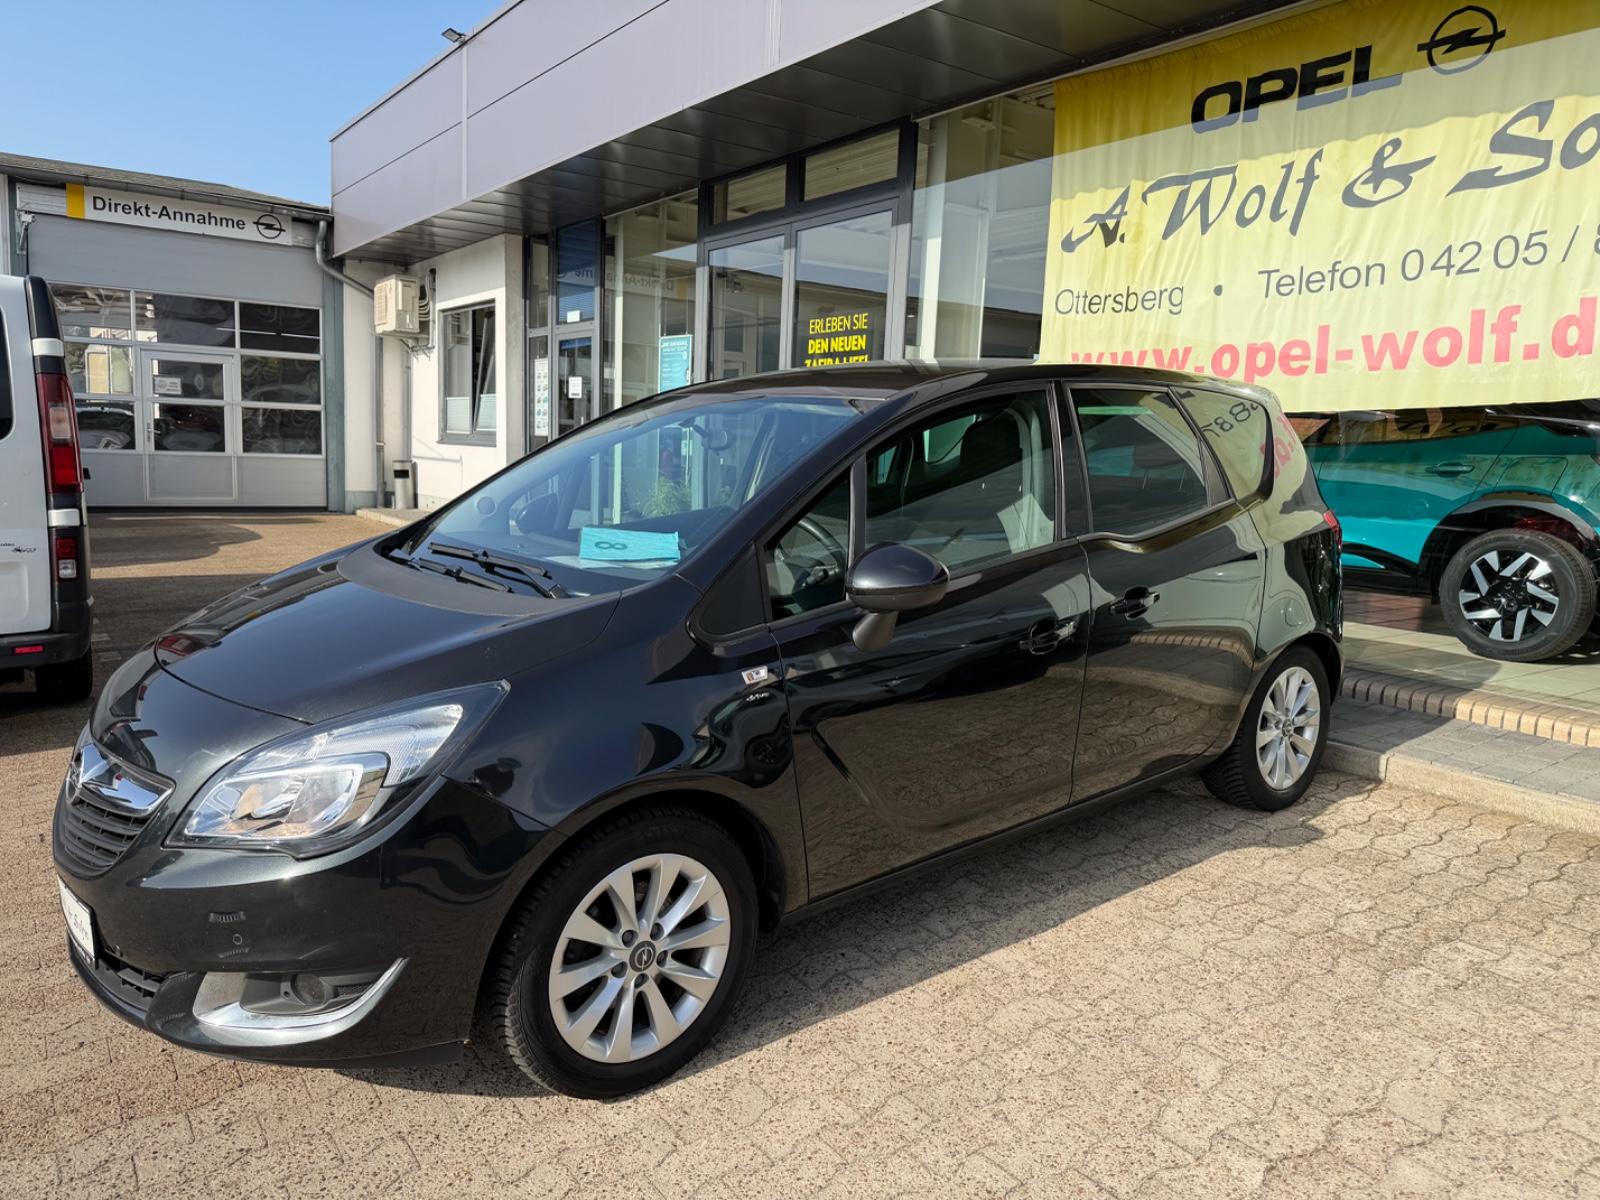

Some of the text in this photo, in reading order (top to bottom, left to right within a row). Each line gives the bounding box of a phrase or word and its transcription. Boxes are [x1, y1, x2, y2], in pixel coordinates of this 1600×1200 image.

[1191, 45, 1404, 134] OPEL
[1141, 148, 1324, 241] Wolf
[1341, 137, 1437, 209] &
[92, 195, 246, 230] Direkt-Annahme
[1055, 286, 1184, 316] Ottersberg
[1258, 260, 1386, 298] Telefon
[808, 334, 866, 354] DEN NEUEN
[809, 313, 868, 335] ERLEBEN SIE
